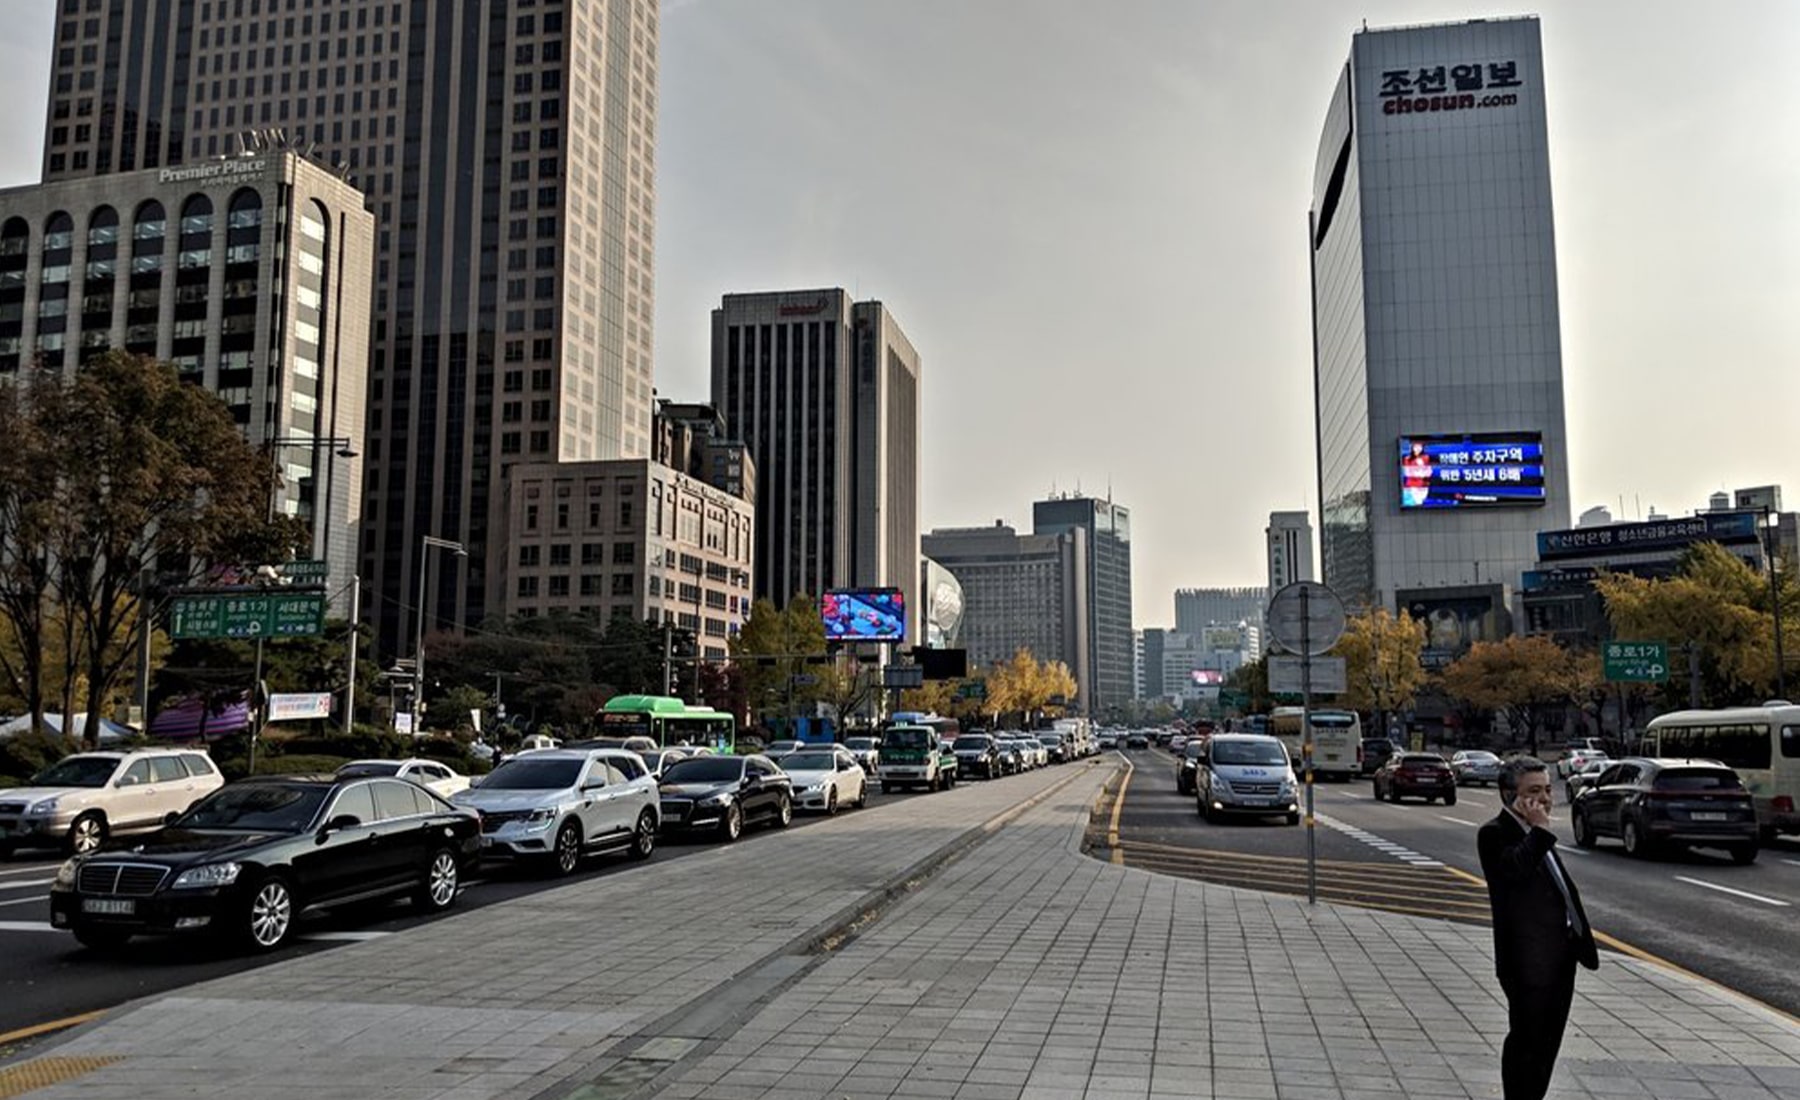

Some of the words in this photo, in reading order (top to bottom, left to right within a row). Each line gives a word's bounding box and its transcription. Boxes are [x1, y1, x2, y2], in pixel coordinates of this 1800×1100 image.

[1379, 61, 1522, 97] 조선일보
[1382, 93, 1517, 116] chosun.com
[159, 163, 221, 182] Premier
[223, 159, 265, 174] Place
[1472, 447, 1523, 463] 주차구역
[1561, 530, 1612, 547] 신한은행
[1608, 645, 1660, 657] 종로1가
